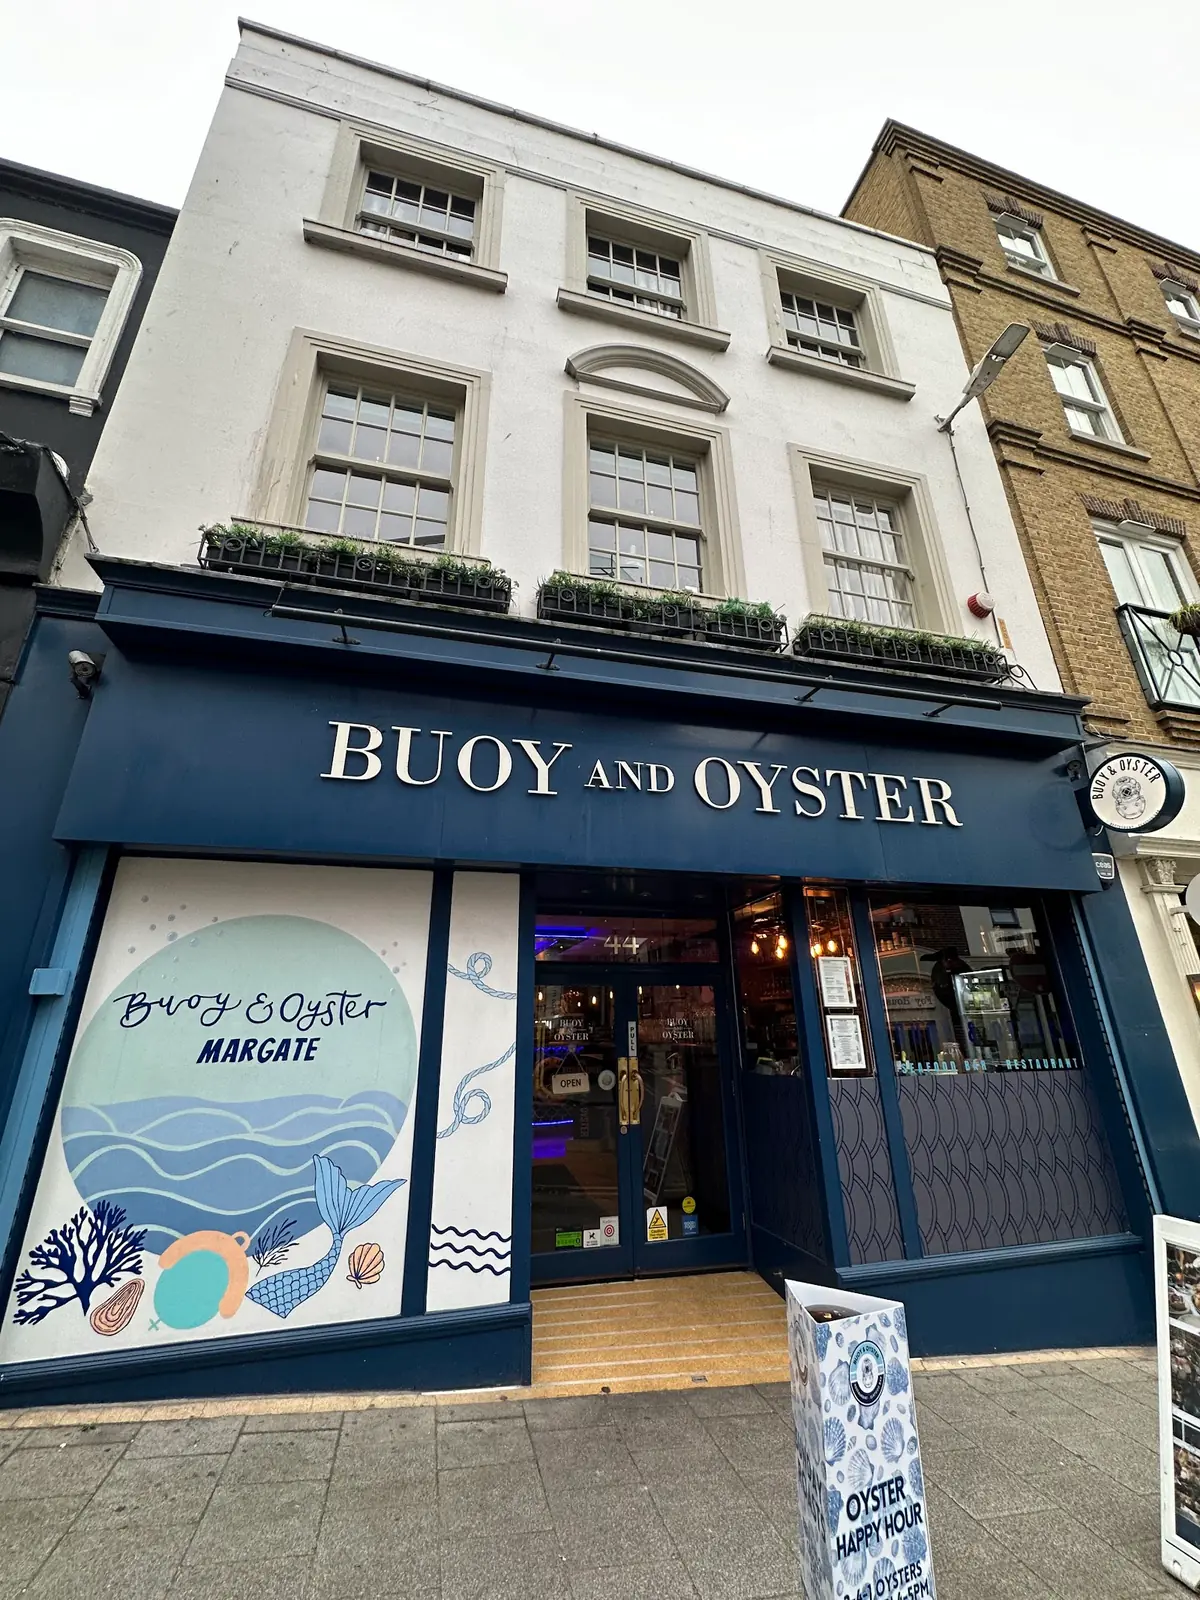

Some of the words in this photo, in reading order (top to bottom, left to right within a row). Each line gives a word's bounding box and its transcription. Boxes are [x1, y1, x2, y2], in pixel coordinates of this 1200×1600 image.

[320, 721, 573, 796] BUOY
[584, 760, 676, 794] AND
[694, 756, 963, 828] OYSTER
[1092, 772, 1110, 800] BUOY
[1107, 765, 1117, 776] &
[1119, 758, 1161, 784] OYSTER
[604, 935, 639, 954] 44
[113, 991, 242, 1028] Buoy
[246, 992, 273, 1024] &
[279, 990, 387, 1032] Oyster
[666, 1018, 688, 1027] BUOY
[560, 1019, 583, 1027] BUOY
[554, 1032, 589, 1041] OYSTER
[662, 1031, 694, 1039] OYSTER
[196, 1037, 321, 1064] MARGATE
[901, 1061, 957, 1074] SEAFOOD
[1006, 1058, 1078, 1070] RESTAURANT
[560, 1079, 582, 1088] OPEN
[846, 1475, 906, 1521] OYSTER
[836, 1519, 881, 1560] HAPPY
[885, 1503, 923, 1539] HOUR
[876, 1560, 922, 1597] OYSTERS
